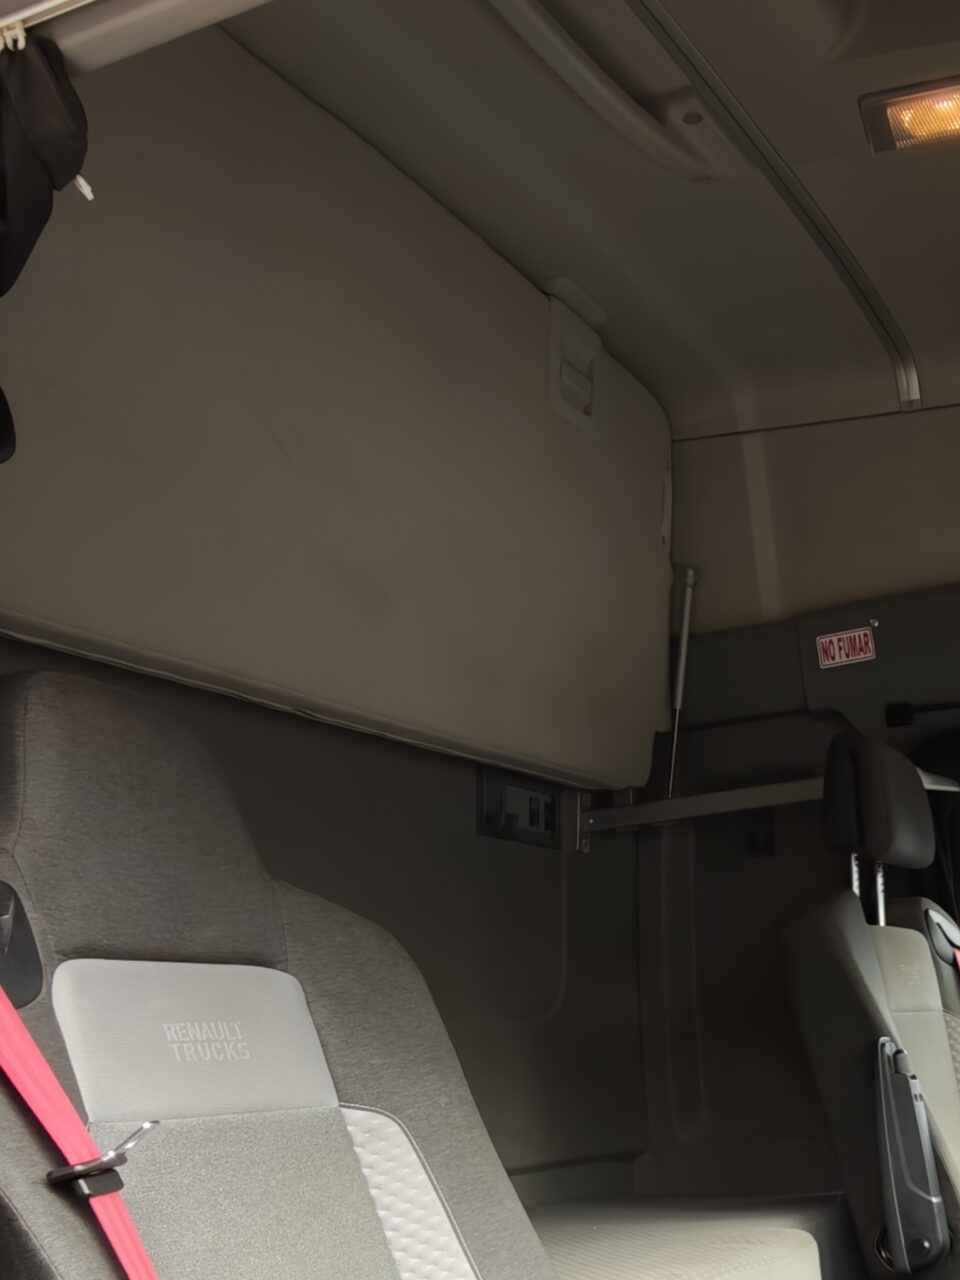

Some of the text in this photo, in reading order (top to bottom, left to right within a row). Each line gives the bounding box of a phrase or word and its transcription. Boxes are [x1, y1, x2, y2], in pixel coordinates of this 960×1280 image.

[821, 632, 872, 663] NO FUMAR
[162, 1020, 243, 1042] RENAULT
[168, 1041, 250, 1062] TRUCKS
